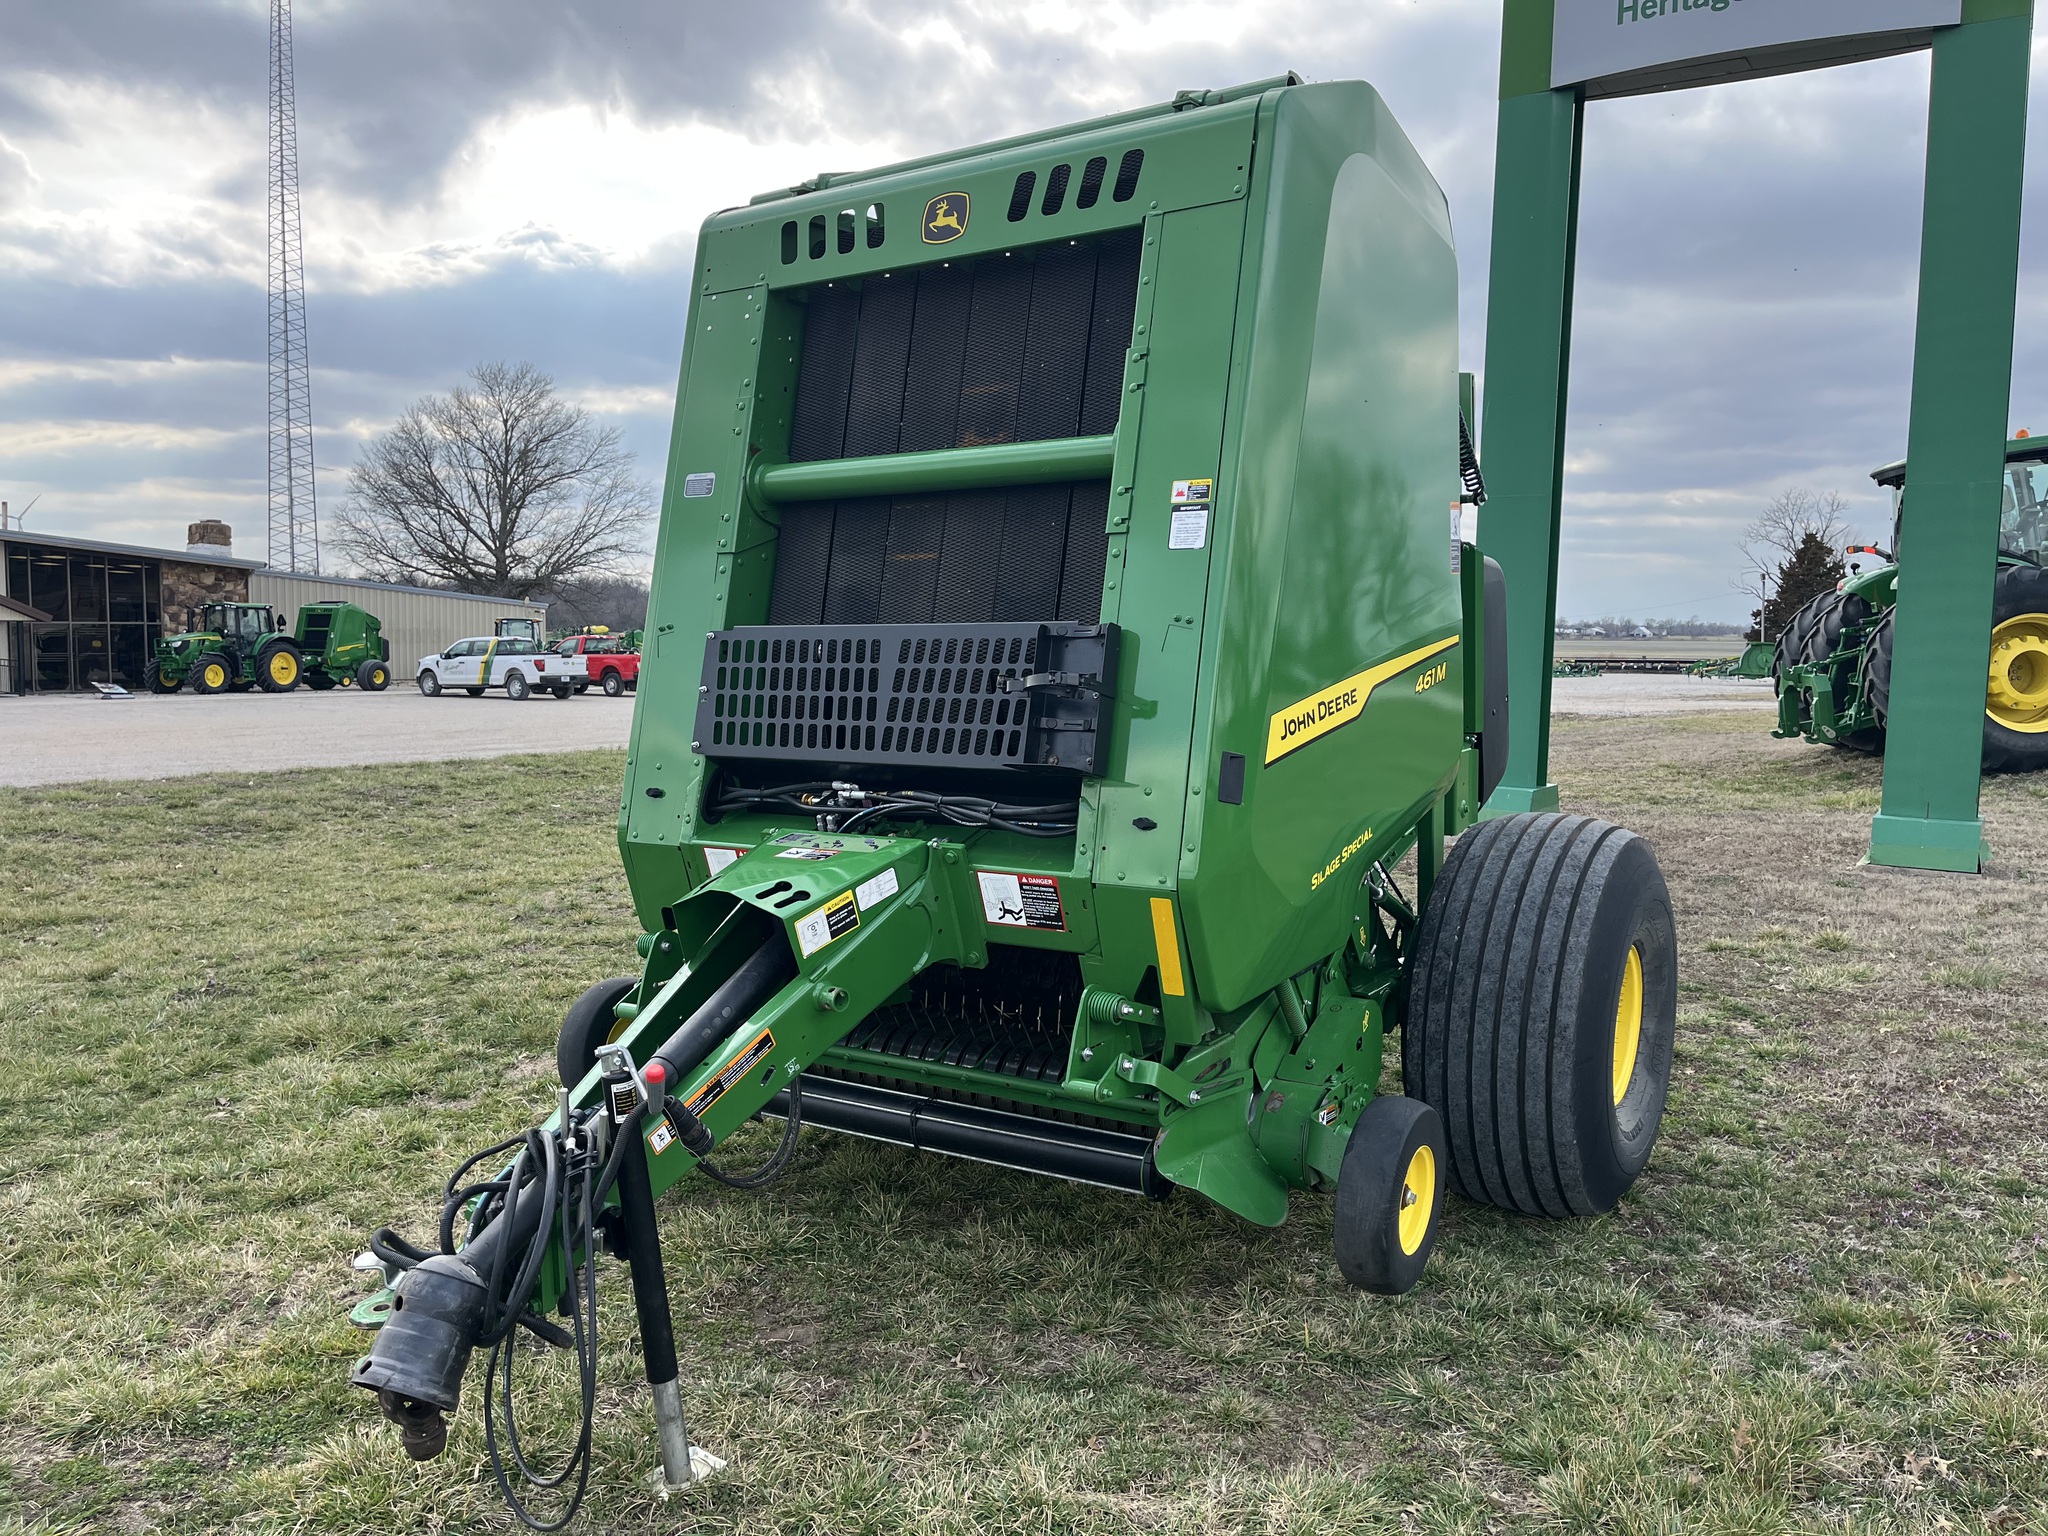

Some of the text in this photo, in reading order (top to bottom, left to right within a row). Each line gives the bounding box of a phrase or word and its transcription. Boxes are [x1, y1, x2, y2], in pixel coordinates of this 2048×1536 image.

[1617, 0, 1743, 25] Heritag
[1414, 661, 1447, 695] 461M
[1281, 688, 1358, 741] JOHN DEERE
[1311, 827, 1373, 890] SILAGE SPECIAL
[1028, 877, 1053, 885] DANGER
[830, 895, 850, 909] CAUTION
[709, 1065, 730, 1087] WARNING
